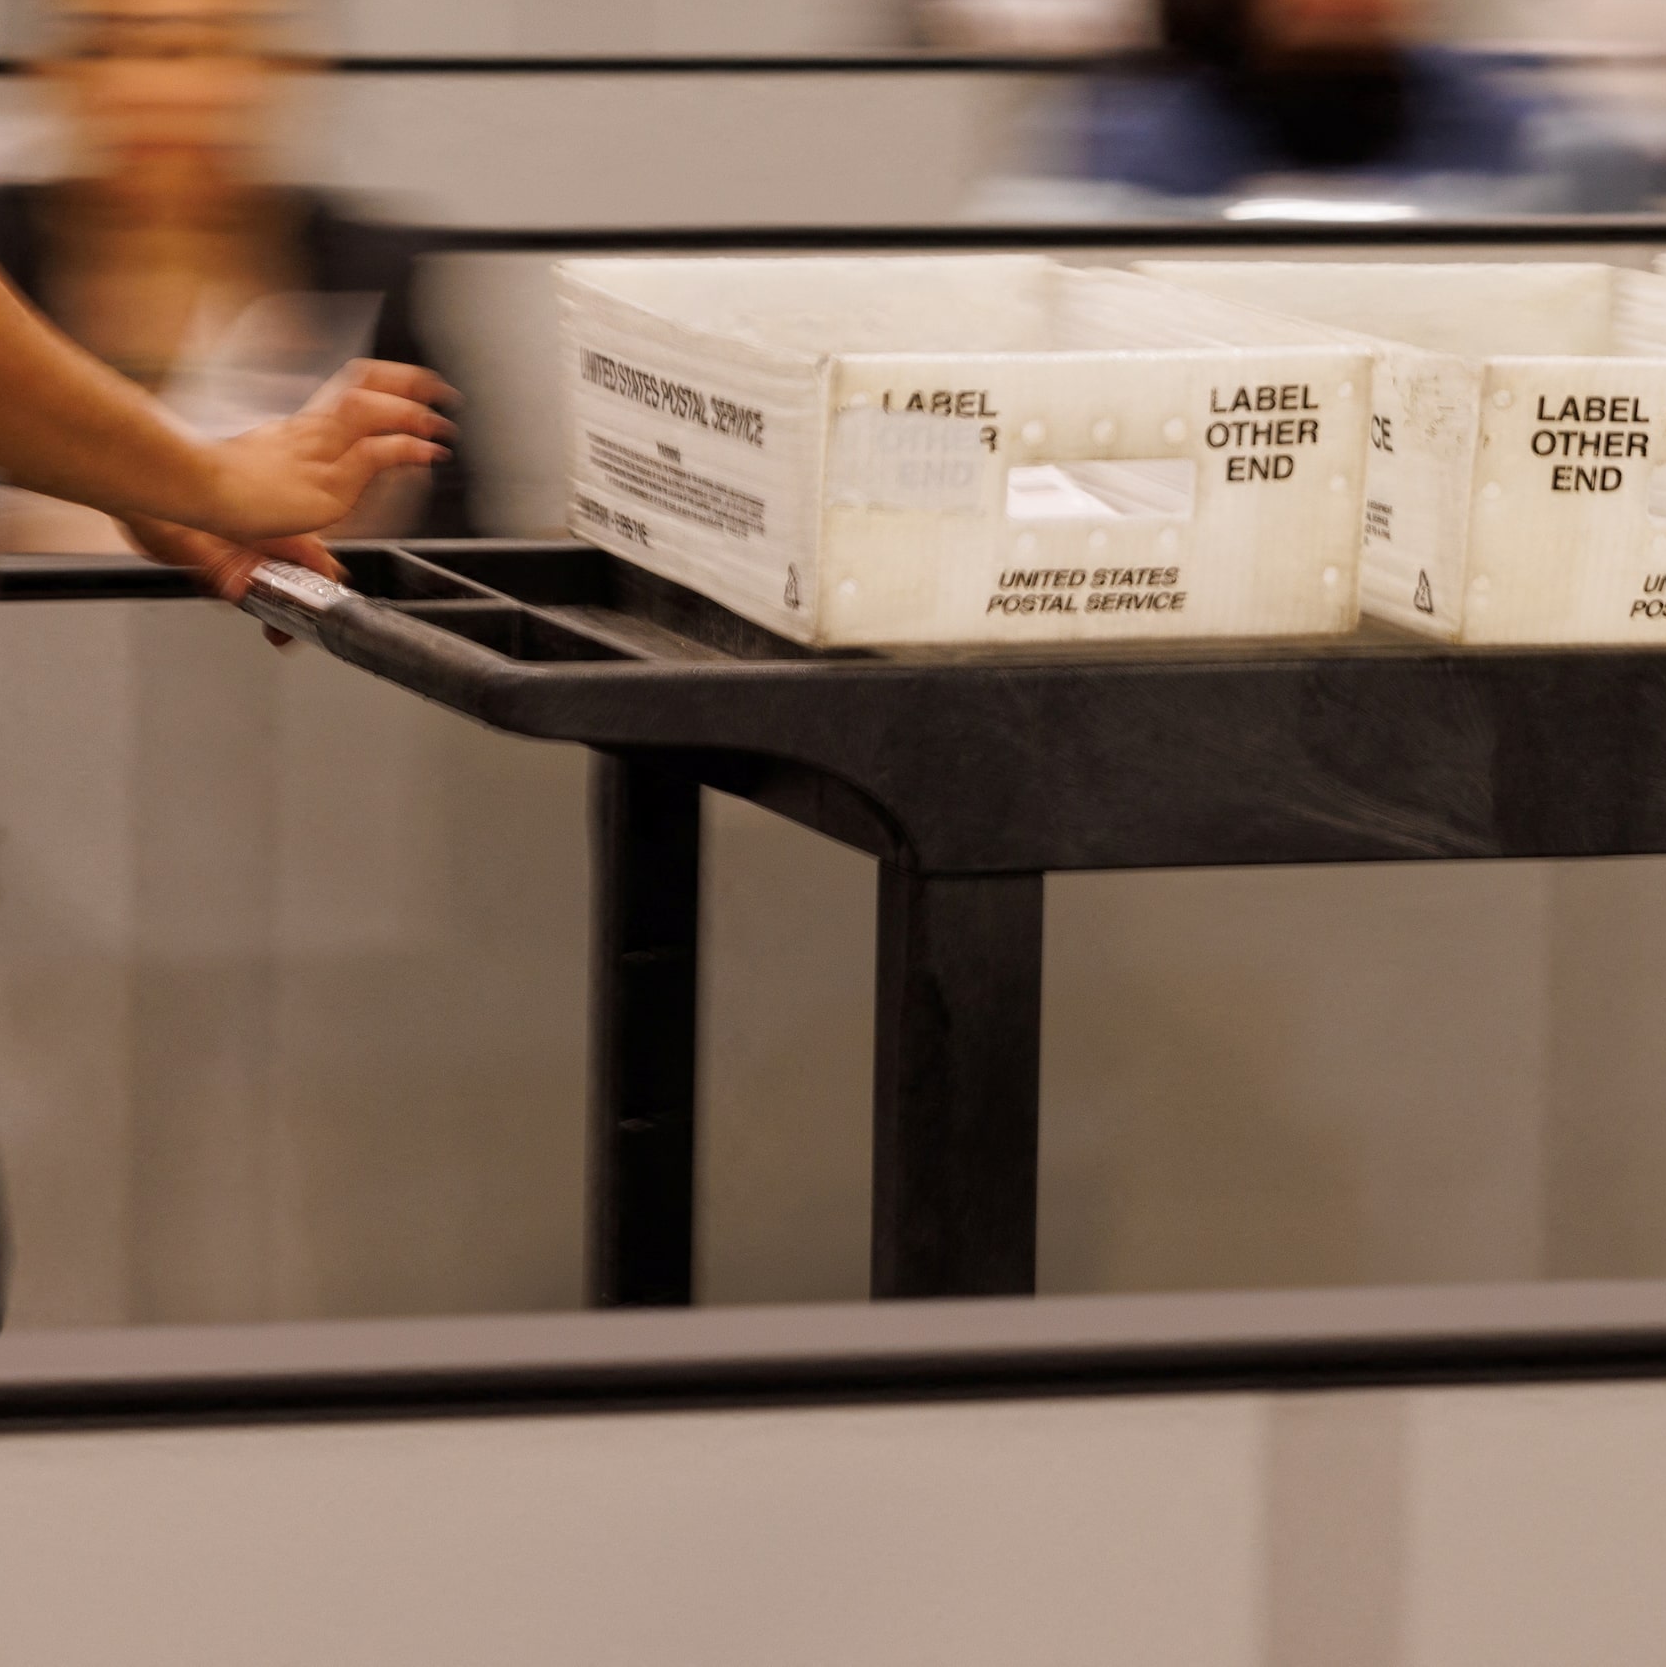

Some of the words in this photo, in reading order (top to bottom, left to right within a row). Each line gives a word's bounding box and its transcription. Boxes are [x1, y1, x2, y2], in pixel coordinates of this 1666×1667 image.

[580, 345, 617, 392] UNITED
[618, 361, 659, 409] STATES
[660, 377, 708, 428] POSTAL
[710, 393, 764, 449] SERVICE
[1210, 383, 1319, 413] LABEL
[1536, 394, 1650, 423] LABEL
[1205, 418, 1319, 449] OTHER
[1530, 428, 1649, 458] OTHER
[1226, 453, 1295, 482] END
[1551, 463, 1623, 493] END
[998, 568, 1087, 589] UNITED
[1090, 566, 1181, 588] STATES
[985, 592, 1079, 615] POSTAL
[1083, 590, 1187, 614] SERVICE
